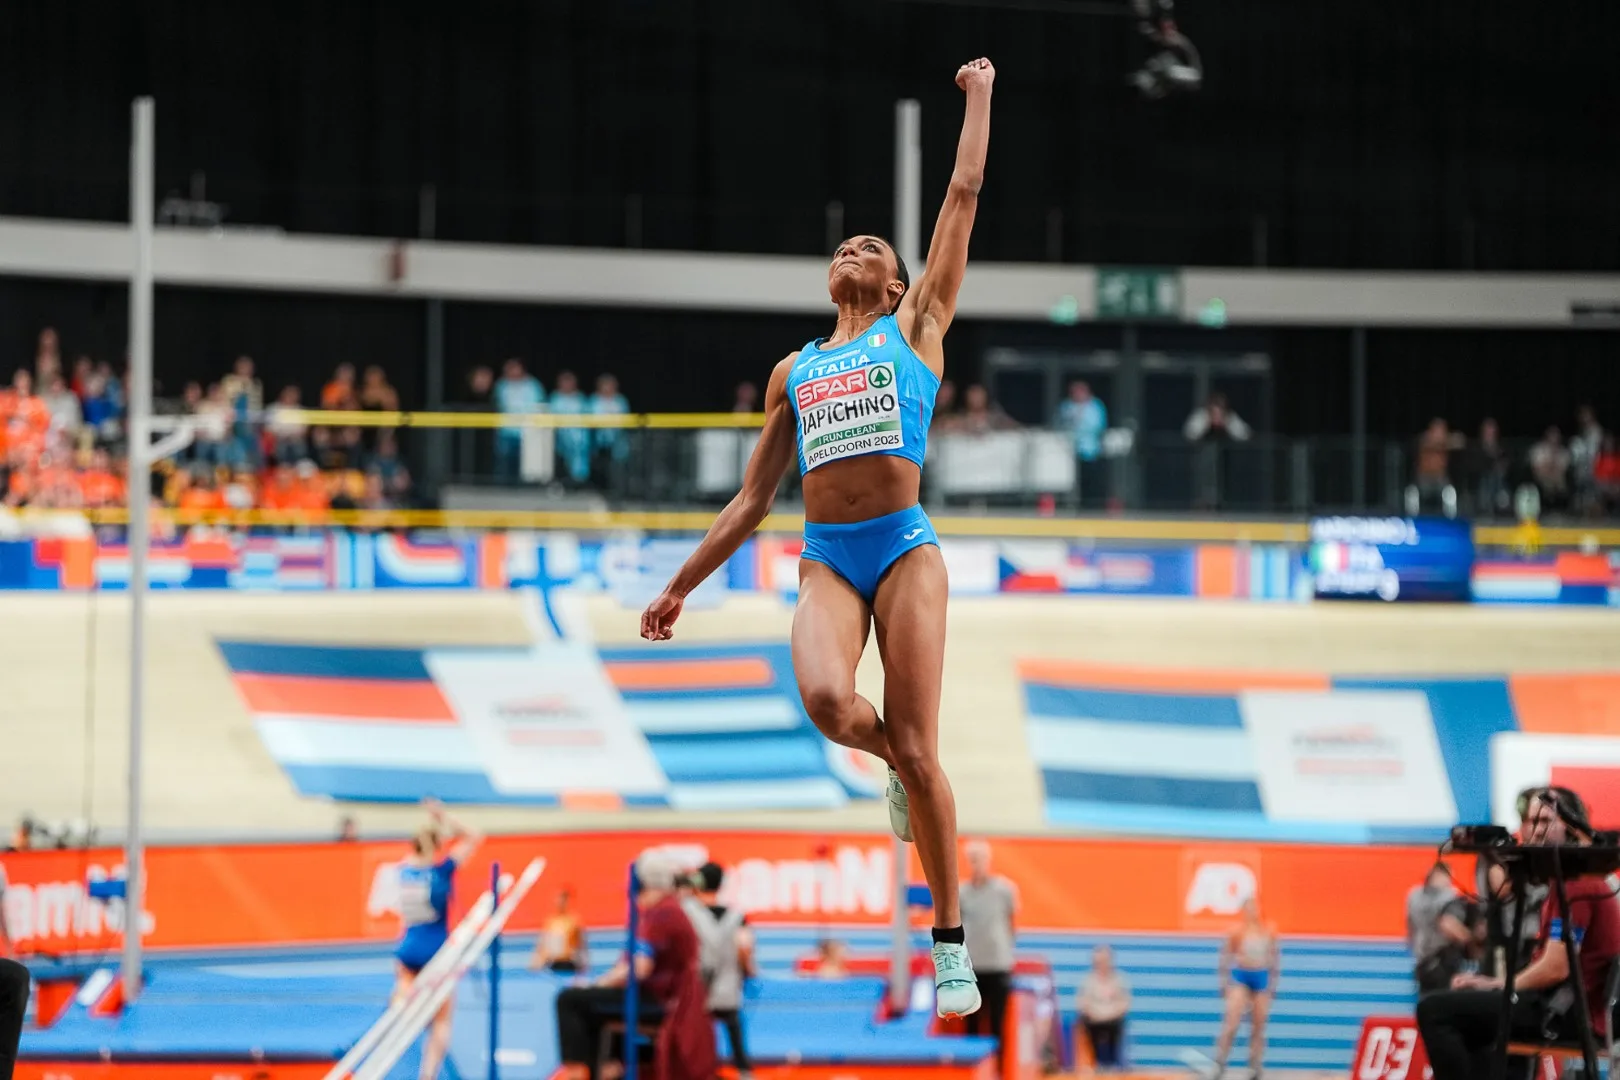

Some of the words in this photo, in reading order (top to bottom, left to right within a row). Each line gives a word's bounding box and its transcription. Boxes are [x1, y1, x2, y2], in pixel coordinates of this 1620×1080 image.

[807, 353, 871, 379] ITALIA
[798, 373, 865, 406] SPAR
[802, 393, 896, 436] IAPICHINO
[808, 438, 872, 465] APELDOORN
[874, 434, 900, 446] 2025
[823, 431, 843, 443] RUN
